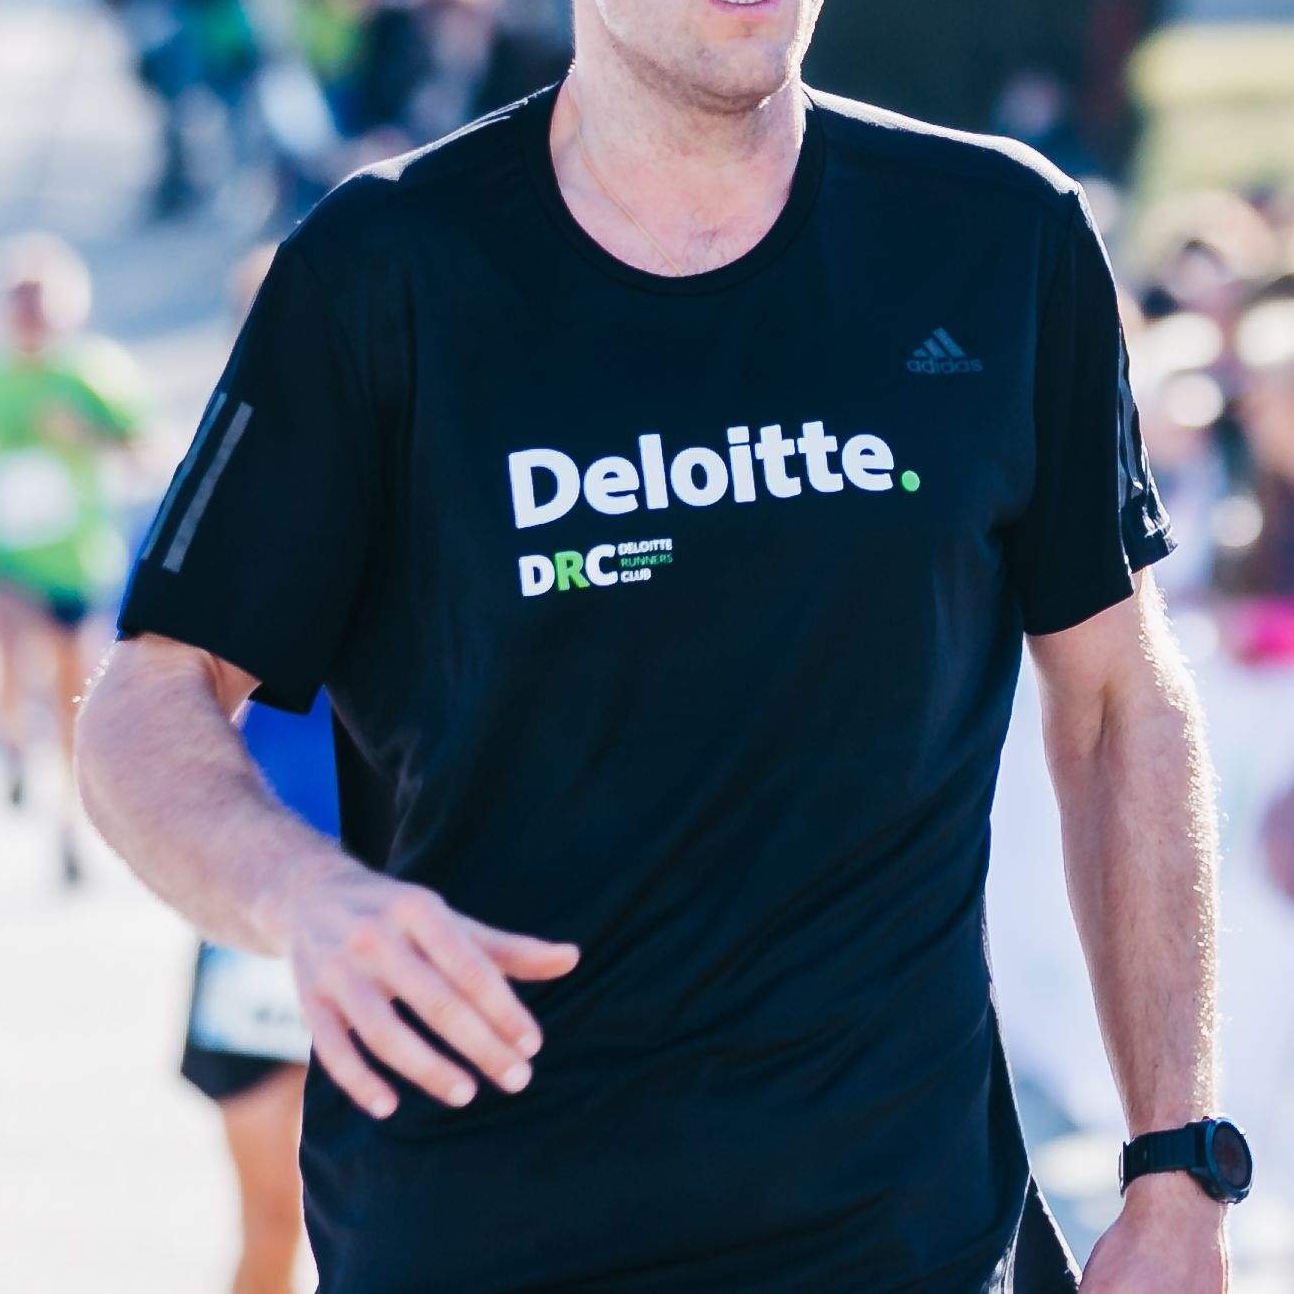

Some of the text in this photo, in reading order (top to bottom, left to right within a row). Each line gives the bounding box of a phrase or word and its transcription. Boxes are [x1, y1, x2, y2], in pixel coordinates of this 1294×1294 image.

[508, 420, 921, 529] Deloitte.
[617, 538, 673, 556] DELOITTE
[620, 553, 674, 568] RUNNERS
[518, 543, 619, 597] DRC
